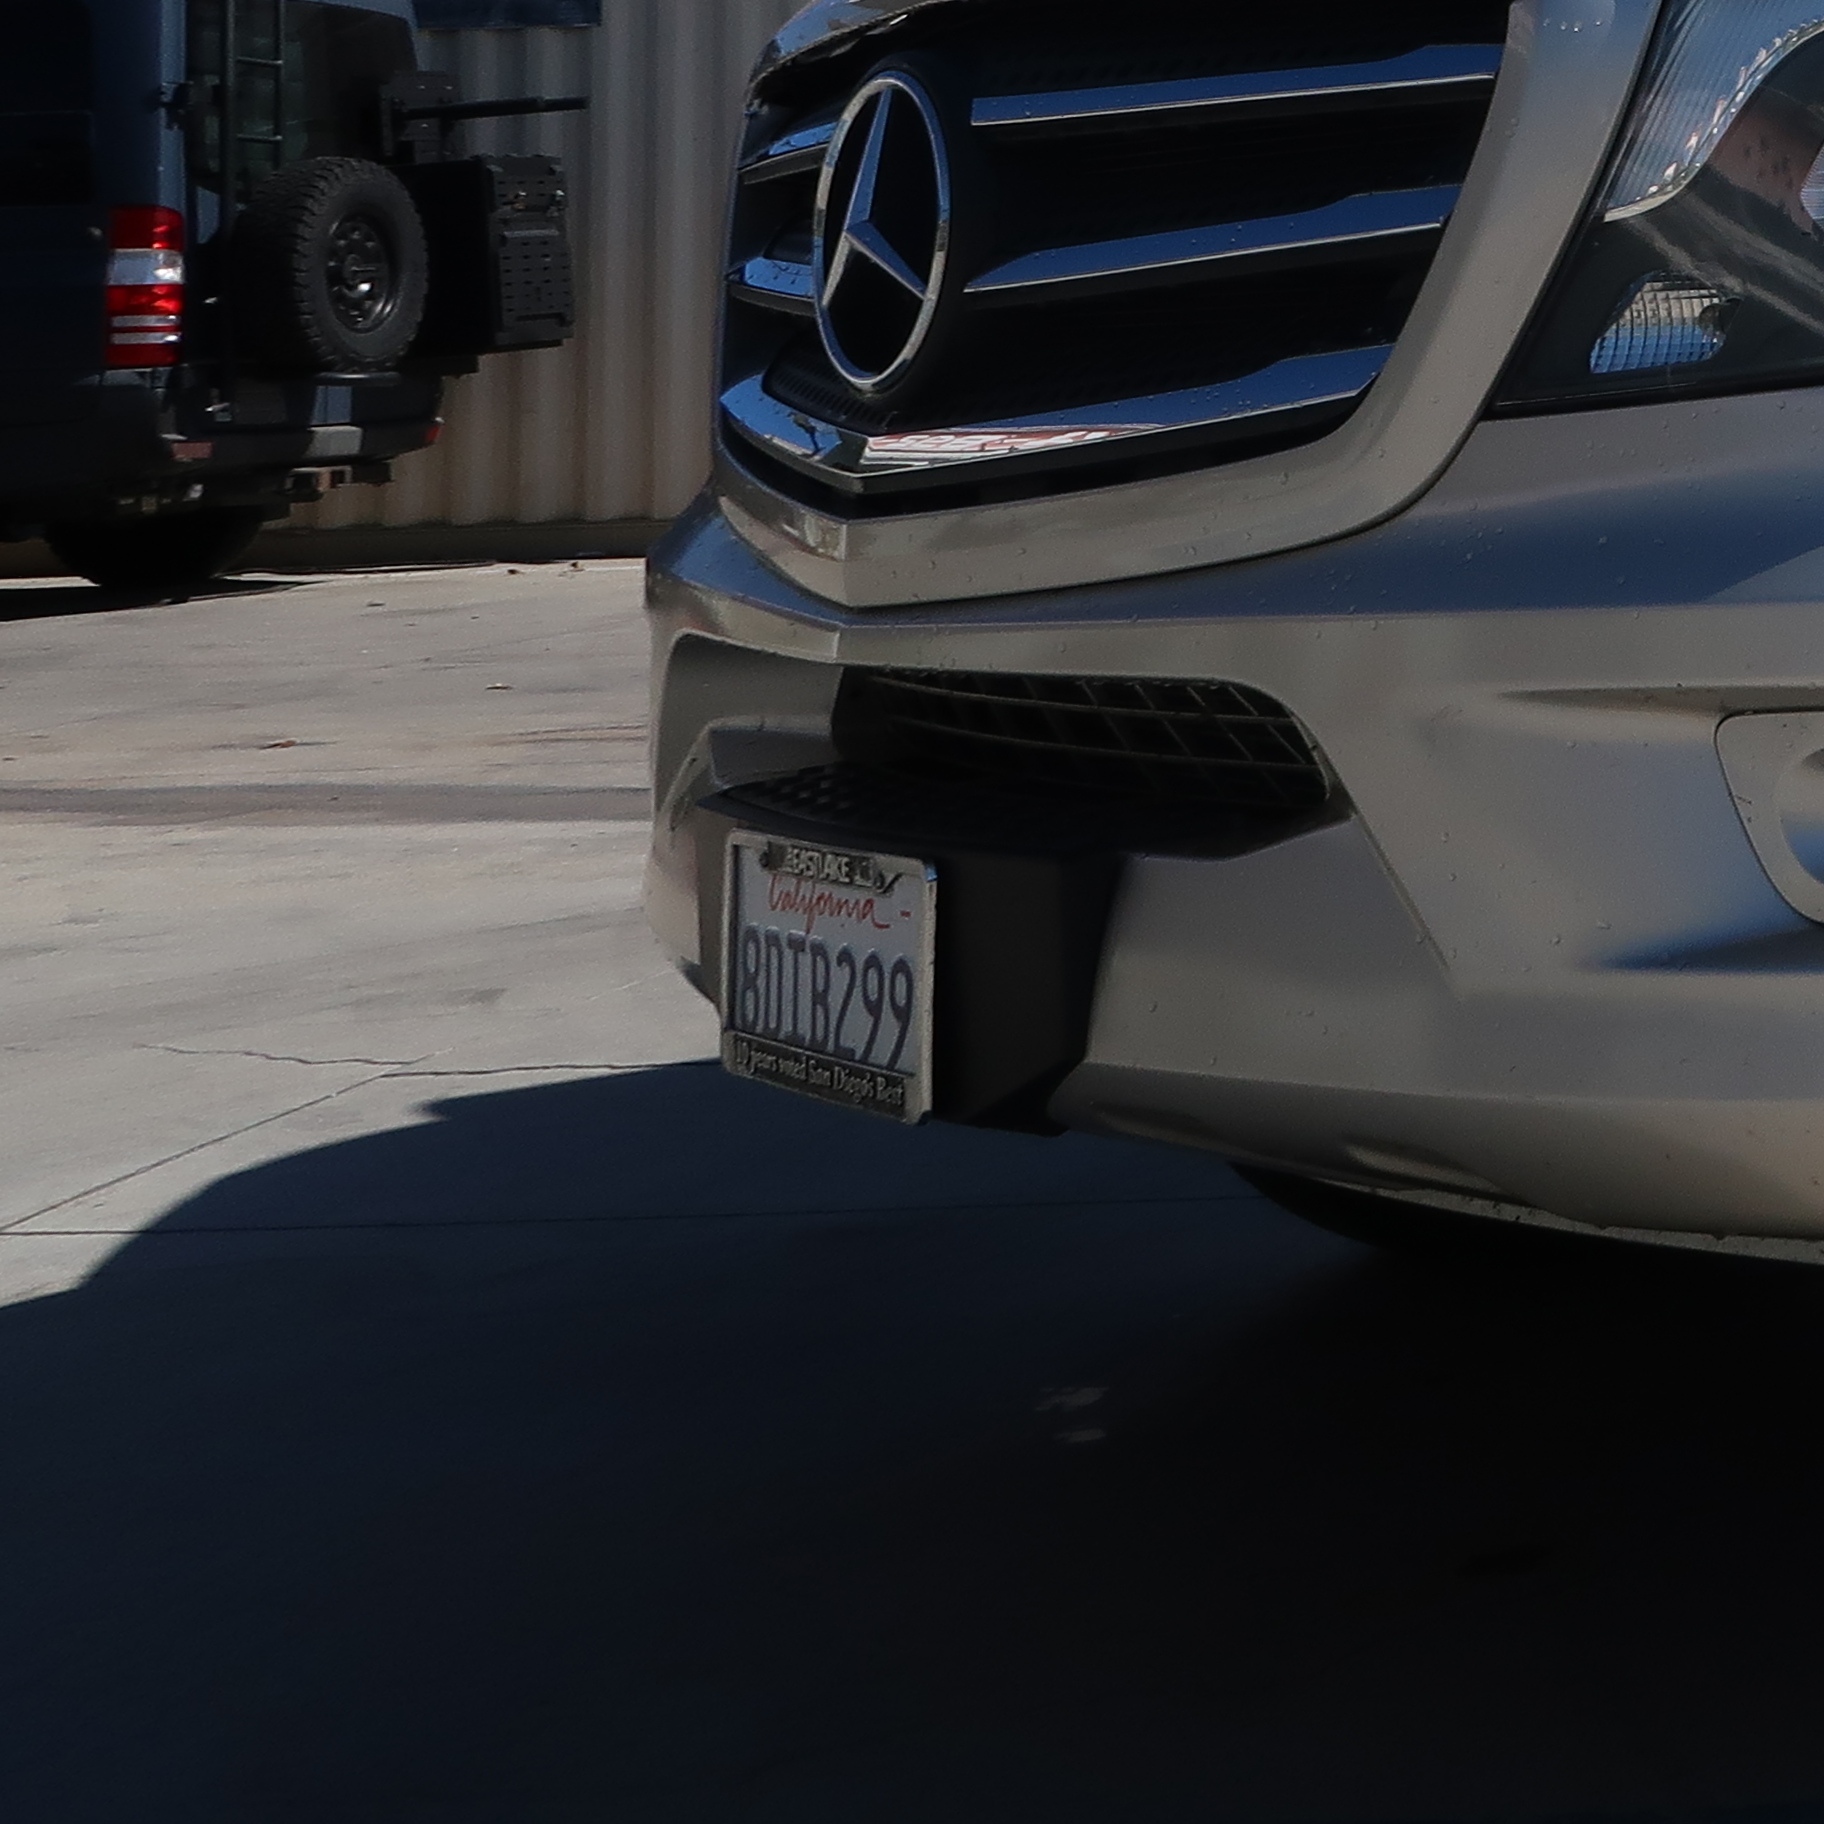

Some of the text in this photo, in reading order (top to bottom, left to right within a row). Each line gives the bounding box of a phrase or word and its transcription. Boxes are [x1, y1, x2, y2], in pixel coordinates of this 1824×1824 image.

[750, 1050, 777, 1074] years
[808, 1059, 832, 1087] San
[833, 1066, 875, 1103] Diego's
[875, 1077, 904, 1107] Best
